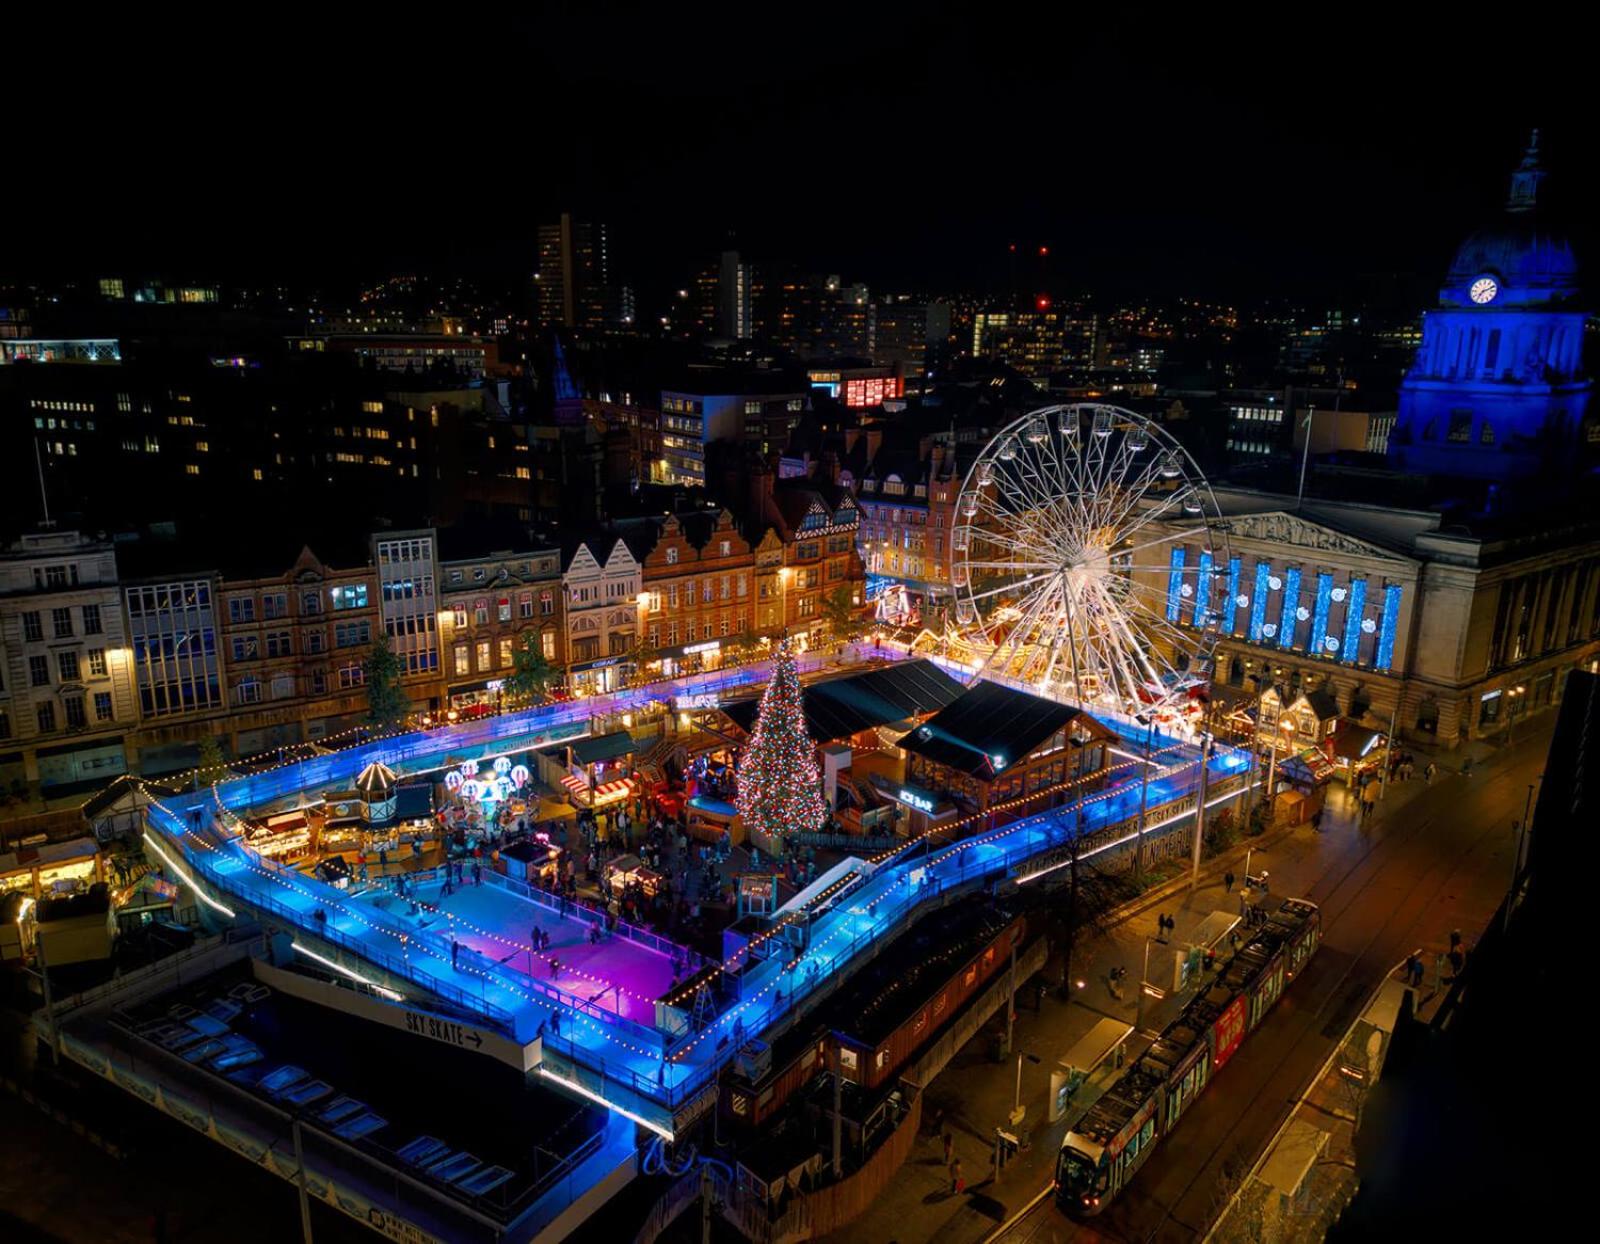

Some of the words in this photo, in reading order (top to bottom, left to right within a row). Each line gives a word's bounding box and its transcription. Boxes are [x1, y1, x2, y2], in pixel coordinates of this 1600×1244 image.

[914, 796, 933, 812] BAR
[406, 1012, 425, 1034] SKY
[429, 1017, 464, 1046] SKATE
